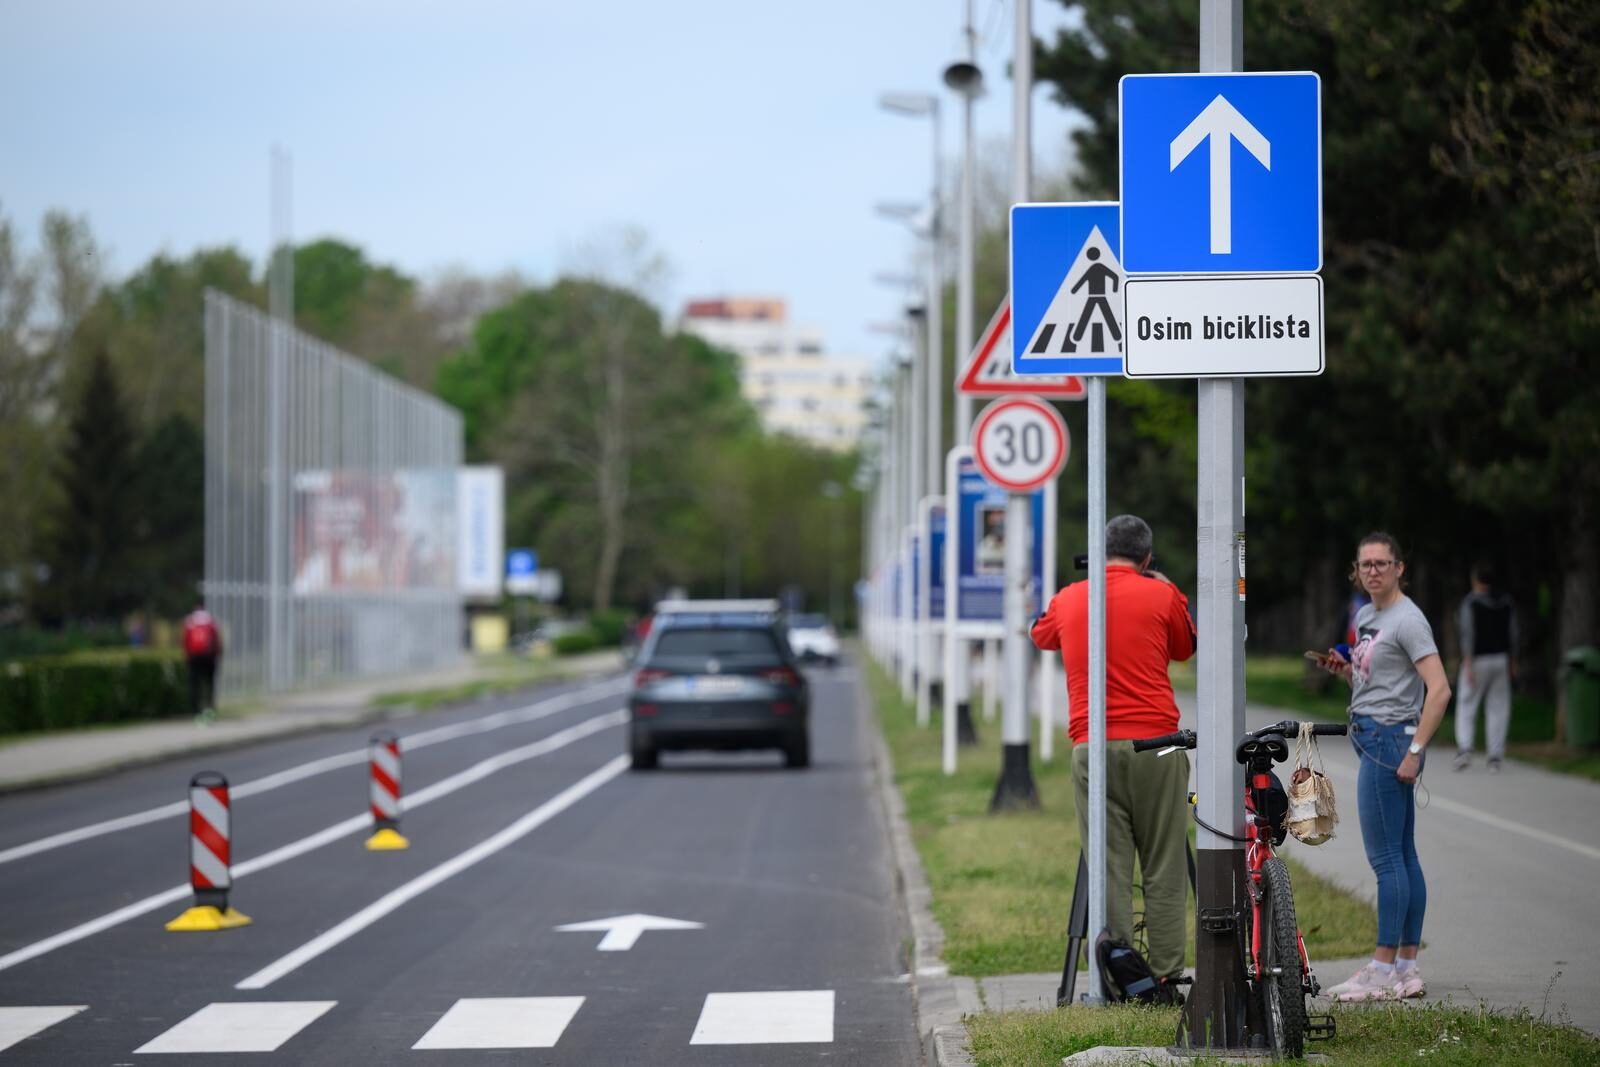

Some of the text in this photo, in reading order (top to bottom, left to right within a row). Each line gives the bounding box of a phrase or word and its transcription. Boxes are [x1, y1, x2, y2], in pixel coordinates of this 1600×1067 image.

[1137, 314, 1310, 341] Osim biciklista
[994, 421, 1045, 466] 30
